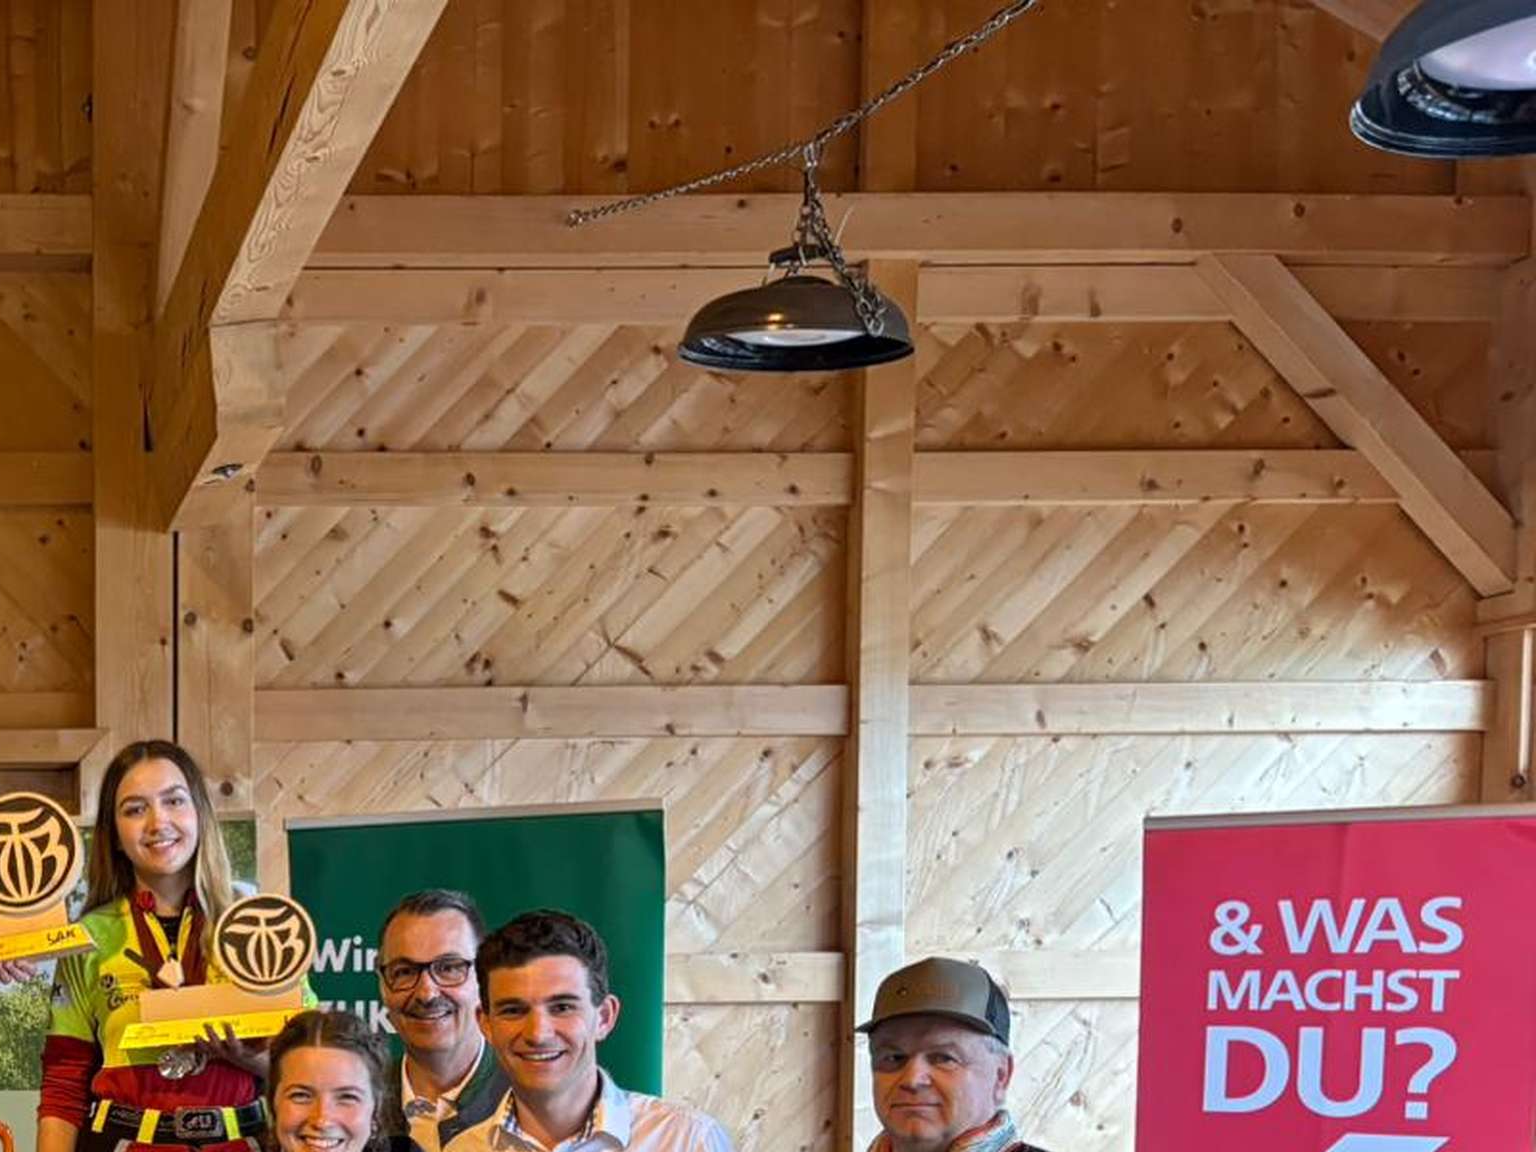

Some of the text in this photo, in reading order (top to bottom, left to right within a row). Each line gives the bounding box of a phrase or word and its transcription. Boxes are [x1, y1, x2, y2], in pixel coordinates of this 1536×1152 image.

[1209, 896, 1463, 955] & WAS
[1207, 968, 1461, 1012] MACHST
[1202, 1024, 1458, 1120] DU?
